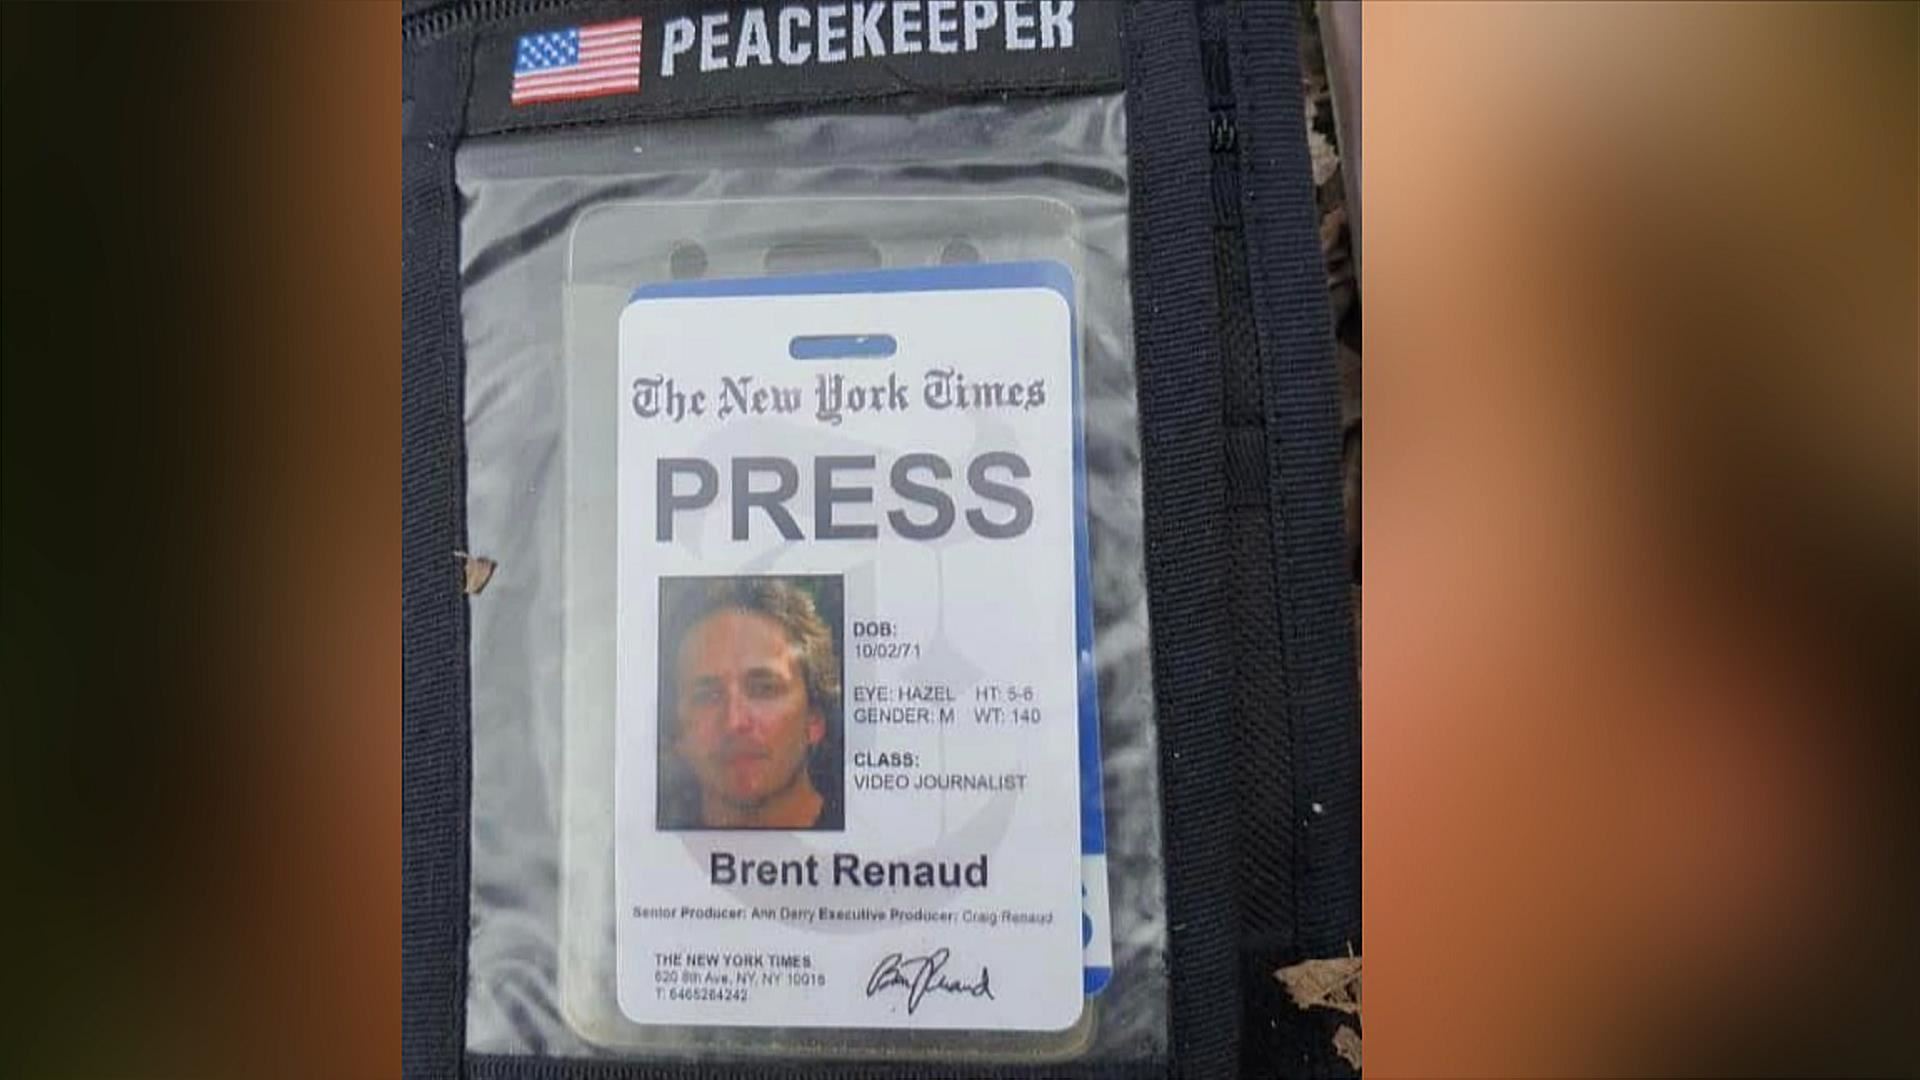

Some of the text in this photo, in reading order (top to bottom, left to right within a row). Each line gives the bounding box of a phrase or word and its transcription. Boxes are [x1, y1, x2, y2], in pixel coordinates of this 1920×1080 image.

[660, 0, 1075, 77] PEACEKEEPER
[632, 368, 1047, 426] The New York Times
[655, 451, 1034, 542] PRESS
[853, 621, 897, 637] DOB:
[855, 643, 921, 659] 10/02/71
[854, 686, 893, 701] EYE:
[898, 686, 956, 702] HAZEL
[975, 686, 1002, 702] HT:
[853, 707, 1042, 724] GENDER: M WT: 140
[854, 751, 920, 768] CLASS:
[854, 774, 1027, 791] VIDEO JOURNALIST
[710, 852, 989, 888] Brent Renaud
[633, 906, 676, 919] Senior
[681, 906, 747, 920] Producer:
[751, 907, 776, 920] Ann
[819, 907, 885, 921] Executive
[890, 908, 956, 922] Producer:
[962, 910, 997, 926] Craig
[1001, 911, 1053, 924] Renaud
[655, 953, 812, 968] THE NEW YORK TIMES
[762, 973, 780, 986] NY
